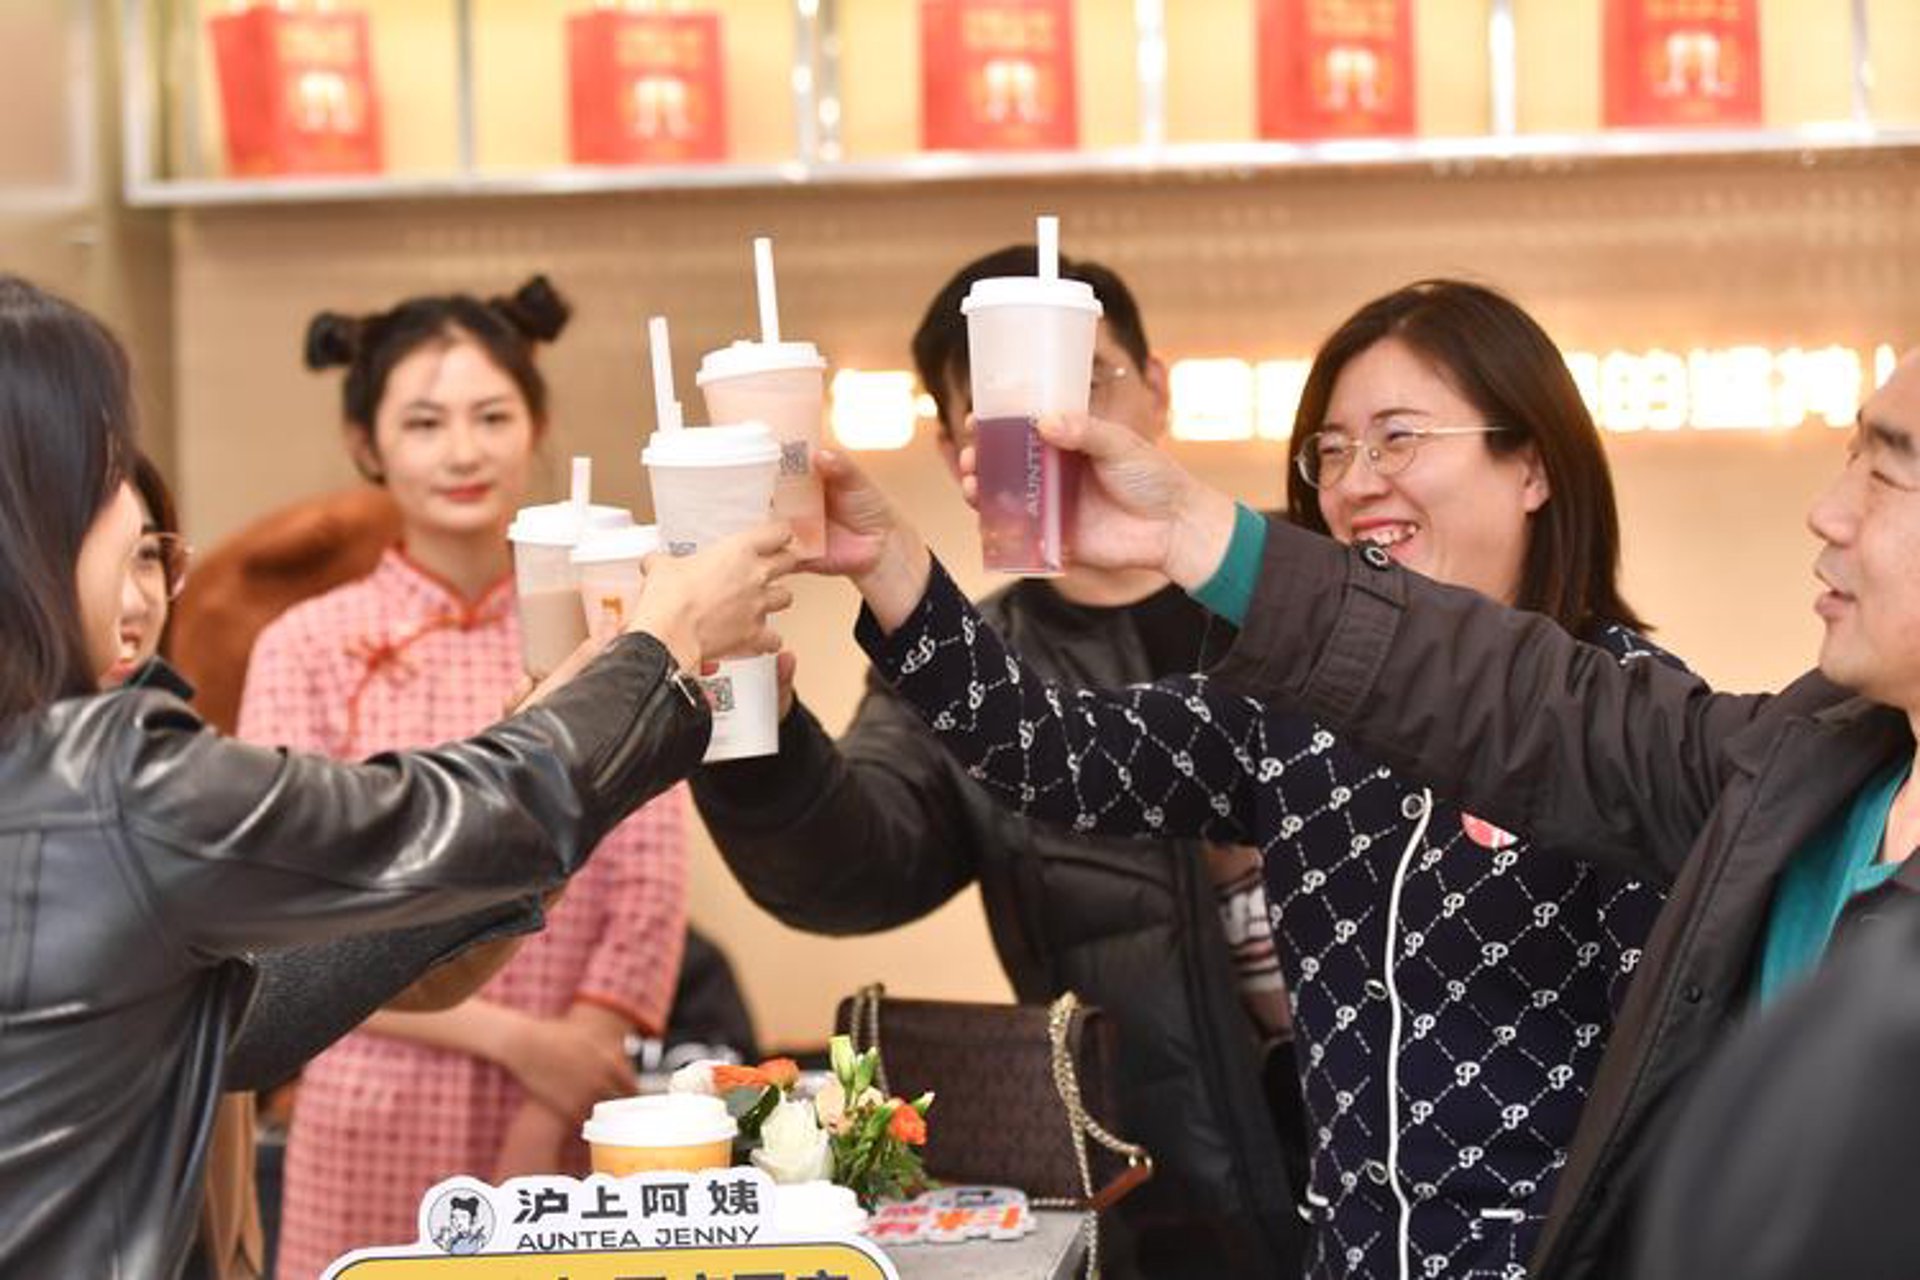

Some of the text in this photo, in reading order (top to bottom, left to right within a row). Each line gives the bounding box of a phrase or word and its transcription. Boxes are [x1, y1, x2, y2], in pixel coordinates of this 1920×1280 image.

[513, 1179, 759, 1224] 沪上阿姨
[516, 1225, 759, 1251] AUNTEA JENNY
